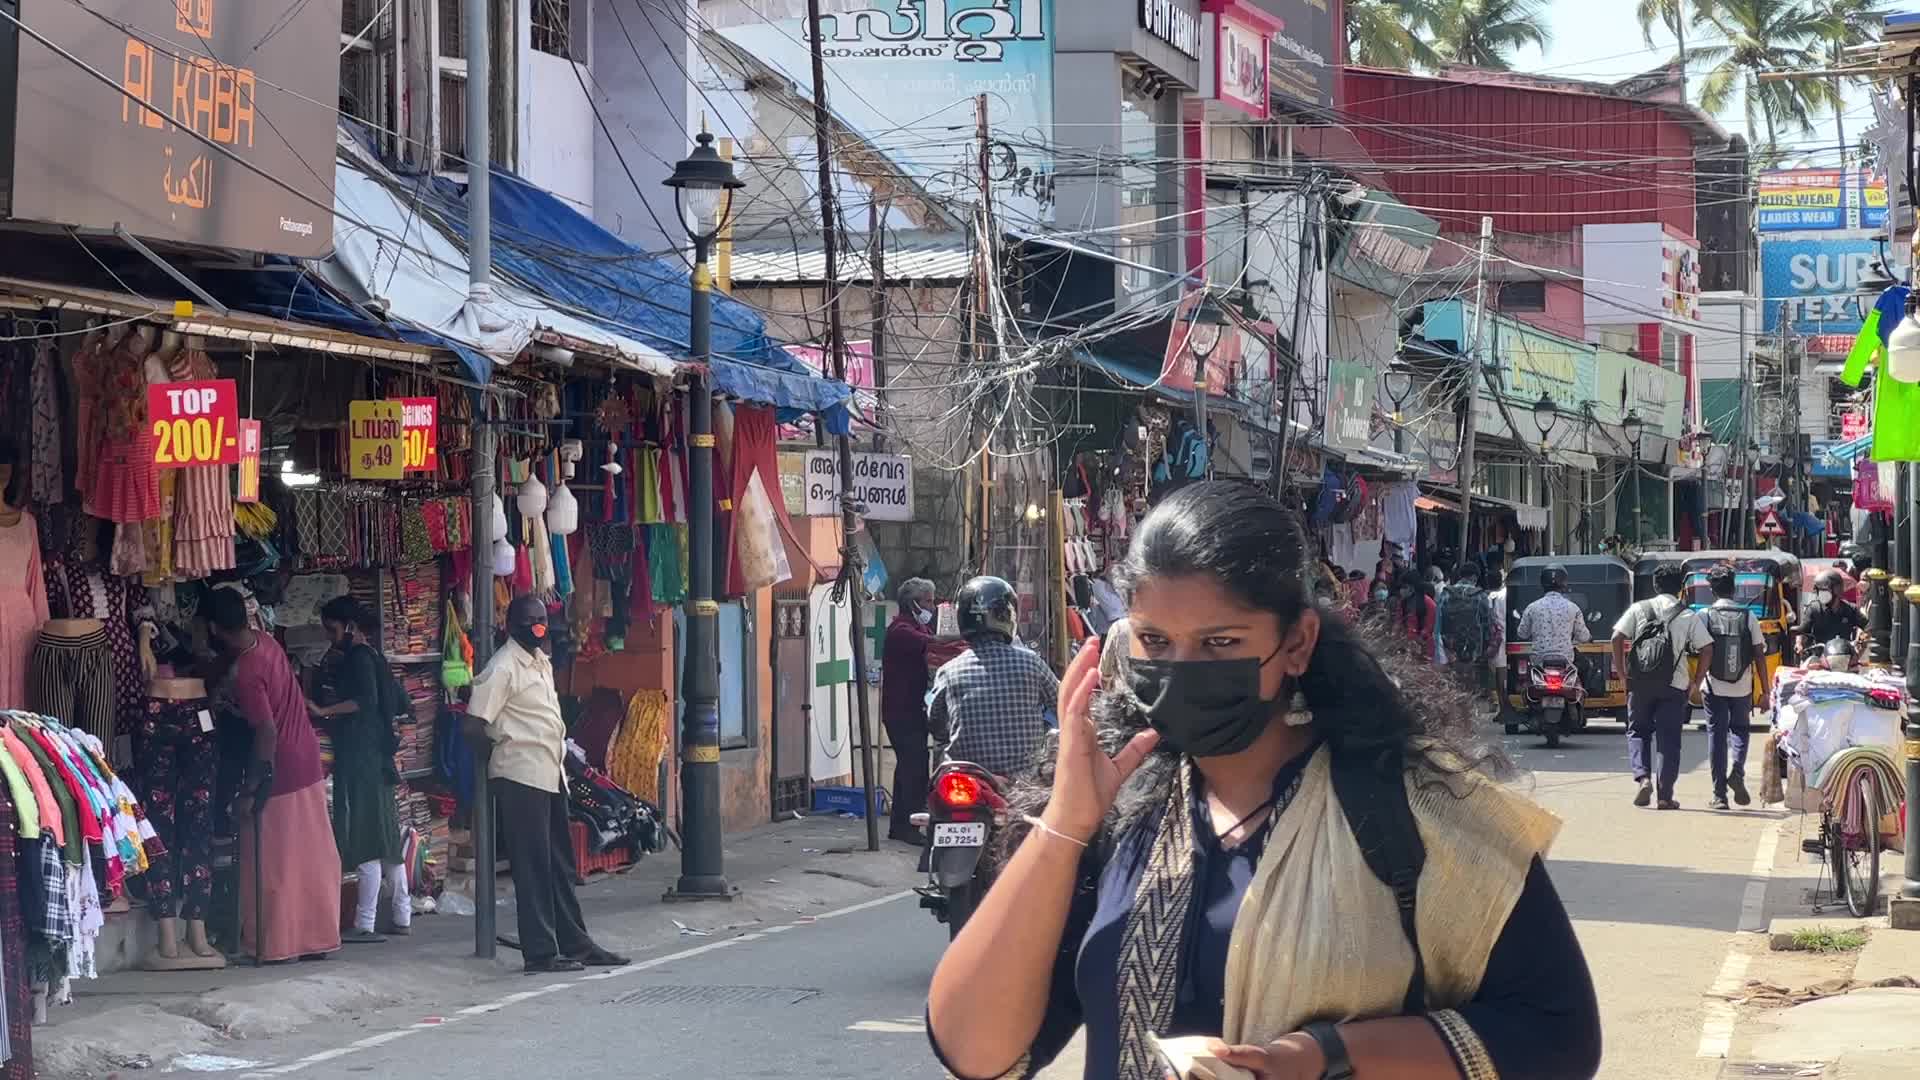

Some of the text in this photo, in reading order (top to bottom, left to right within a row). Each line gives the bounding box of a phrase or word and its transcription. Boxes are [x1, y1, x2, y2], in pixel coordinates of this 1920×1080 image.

[123, 37, 256, 147] AL KABA
[1796, 192, 1834, 206] WEAR
[1761, 210, 1835, 225] LADIES WEAR
[166, 388, 217, 415] TOP
[153, 417, 236, 463] 200/-
